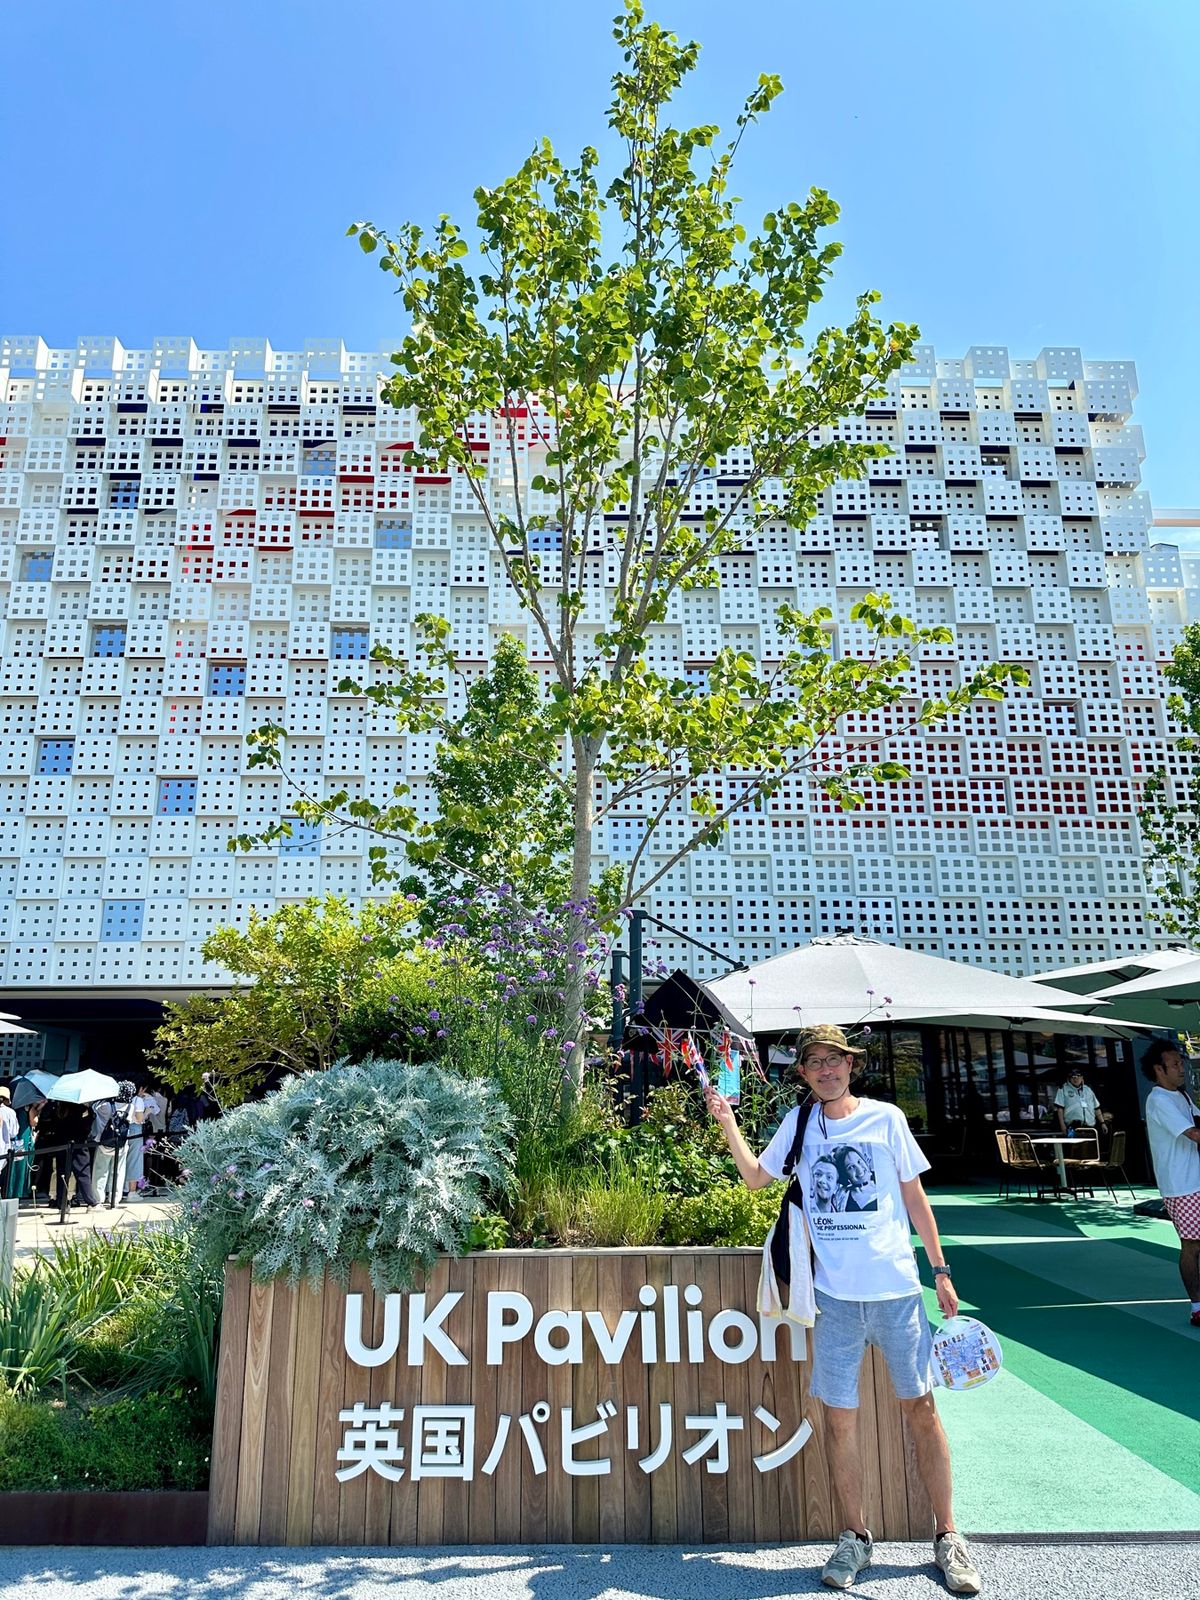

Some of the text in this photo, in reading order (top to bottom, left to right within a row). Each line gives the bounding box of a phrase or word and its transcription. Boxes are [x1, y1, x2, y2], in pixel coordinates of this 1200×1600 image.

[344, 1284, 808, 1367] UK Pavilion
[335, 1400, 813, 1483] 英国パビリオン
